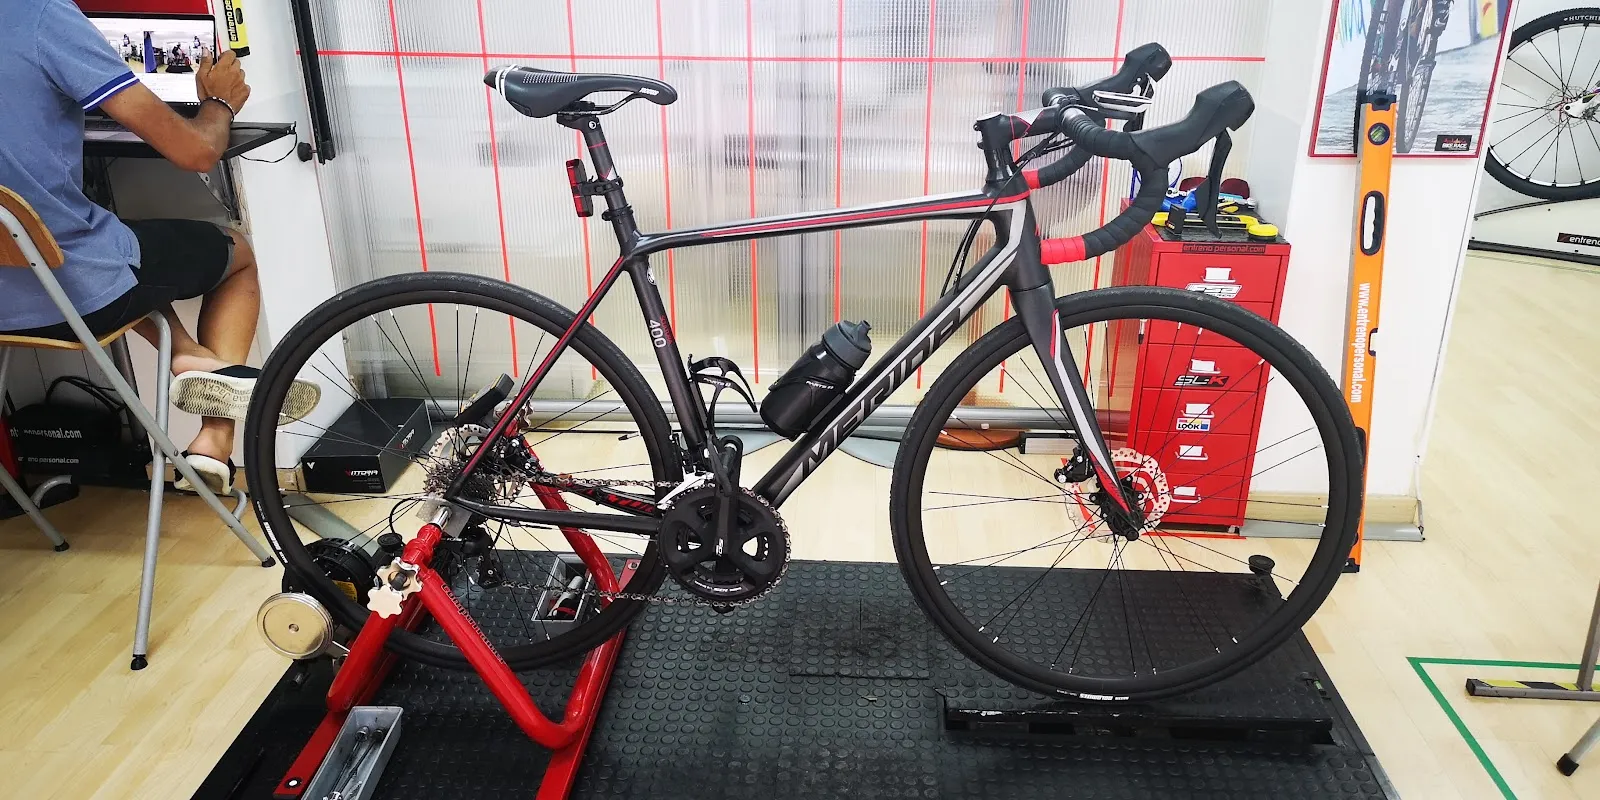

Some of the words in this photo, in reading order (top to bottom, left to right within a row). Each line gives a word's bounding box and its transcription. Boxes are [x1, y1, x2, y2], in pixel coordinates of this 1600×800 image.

[227, 11, 237, 42] entreno
[1183, 244, 1212, 252] entreno
[1213, 244, 1265, 254] personal.com
[650, 319, 667, 348] 400
[1350, 282, 1370, 403] www.entrenopersonal.com
